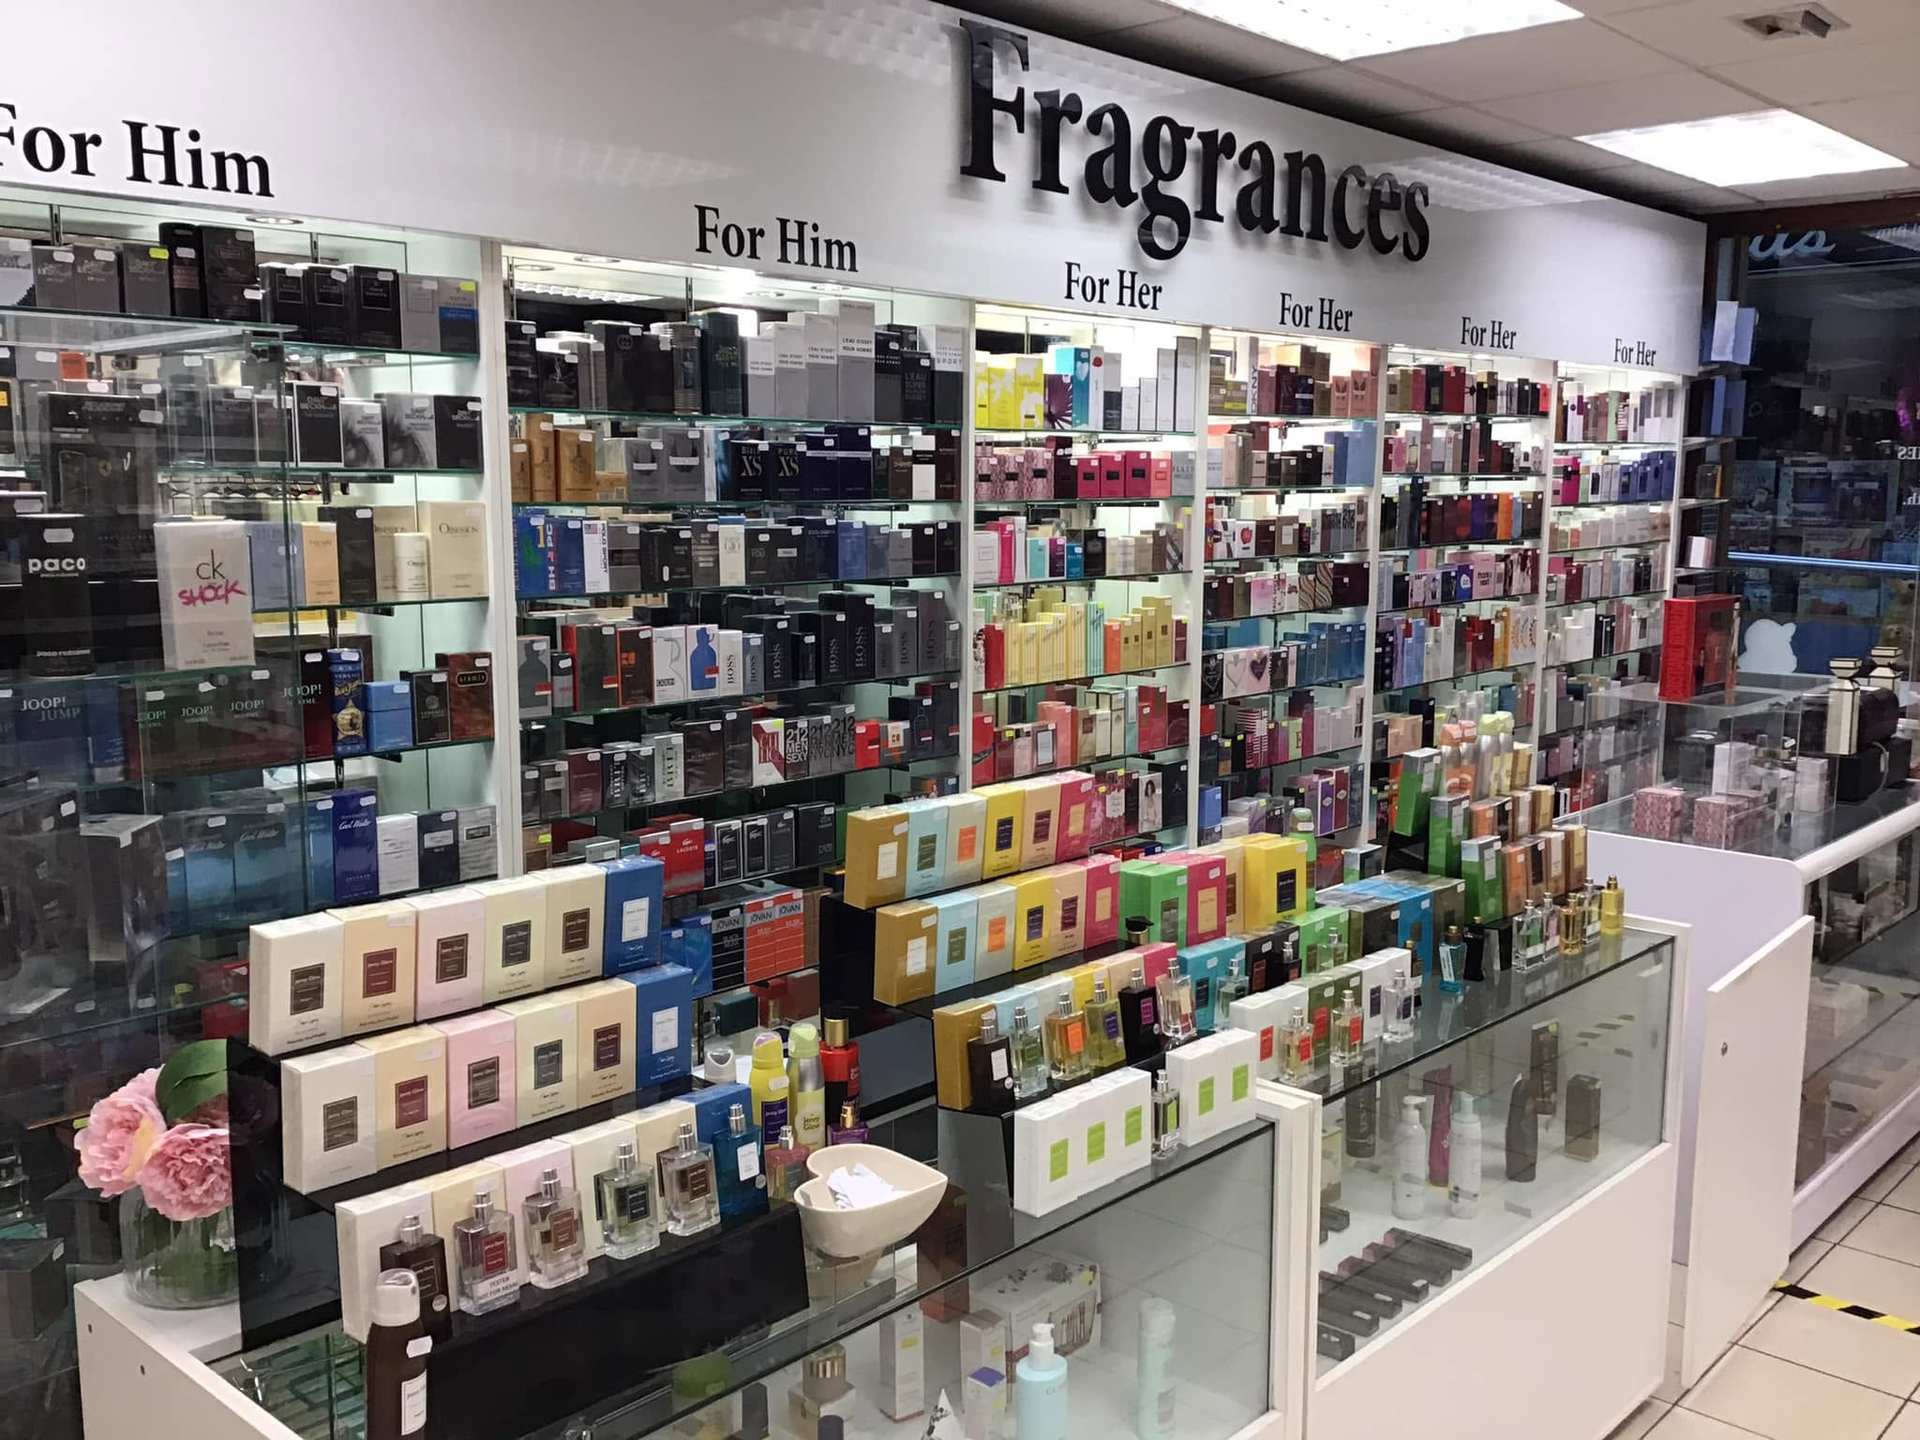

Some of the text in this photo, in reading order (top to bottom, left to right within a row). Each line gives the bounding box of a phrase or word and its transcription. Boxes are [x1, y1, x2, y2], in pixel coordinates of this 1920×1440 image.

[960, 18, 1430, 262] Fragrances
[0, 103, 274, 197] For Him
[693, 205, 859, 273] For Him
[1065, 262, 1163, 311] For Her
[1279, 293, 1353, 333] For Her
[1460, 316, 1517, 350] For Her
[1613, 338, 1657, 367] For Her
[740, 455, 763, 477] XS
[28, 557, 86, 574] paco
[196, 549, 228, 581] ck
[178, 579, 247, 607] SHOCK
[855, 625, 864, 668] BOSS
[727, 653, 735, 685] BOSS
[773, 643, 781, 679] BOSS
[20, 697, 67, 712] JOOP!
[180, 705, 213, 718] JOOP!
[230, 700, 265, 712] JOOP!
[38, 707, 81, 722] JUMP
[810, 723, 833, 738] 212
[832, 716, 856, 733] 212
[785, 728, 808, 742] 212
[785, 741, 808, 753] MEN
[833, 742, 856, 757] NYC
[785, 752, 808, 763] SEXY
[750, 910, 773, 924] JOVAN
[778, 903, 801, 917] JOVAN
[715, 917, 740, 931] JOVAN
